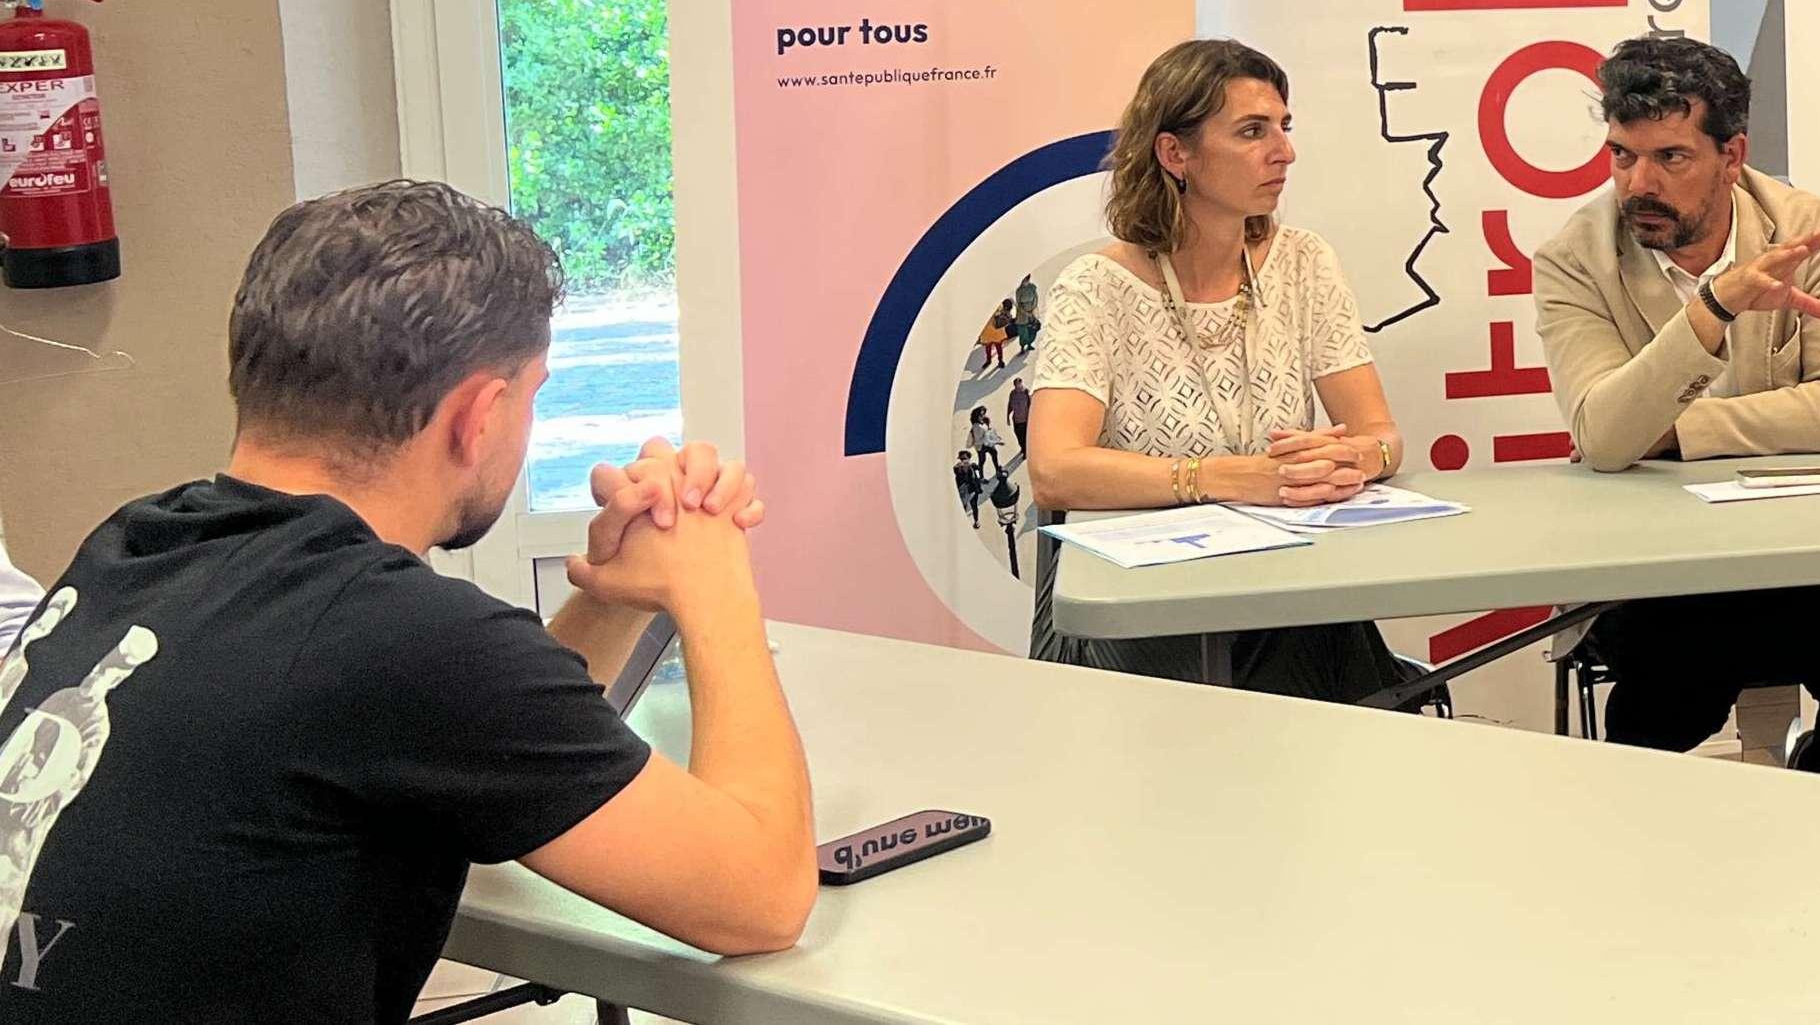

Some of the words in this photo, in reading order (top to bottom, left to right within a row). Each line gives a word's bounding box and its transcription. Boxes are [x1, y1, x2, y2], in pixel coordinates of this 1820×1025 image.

[776, 26, 852, 56] pour
[858, 18, 929, 45] tous
[777, 65, 997, 89] www.santepubliquefrance.fr
[8, 172, 75, 188] eurofeu
